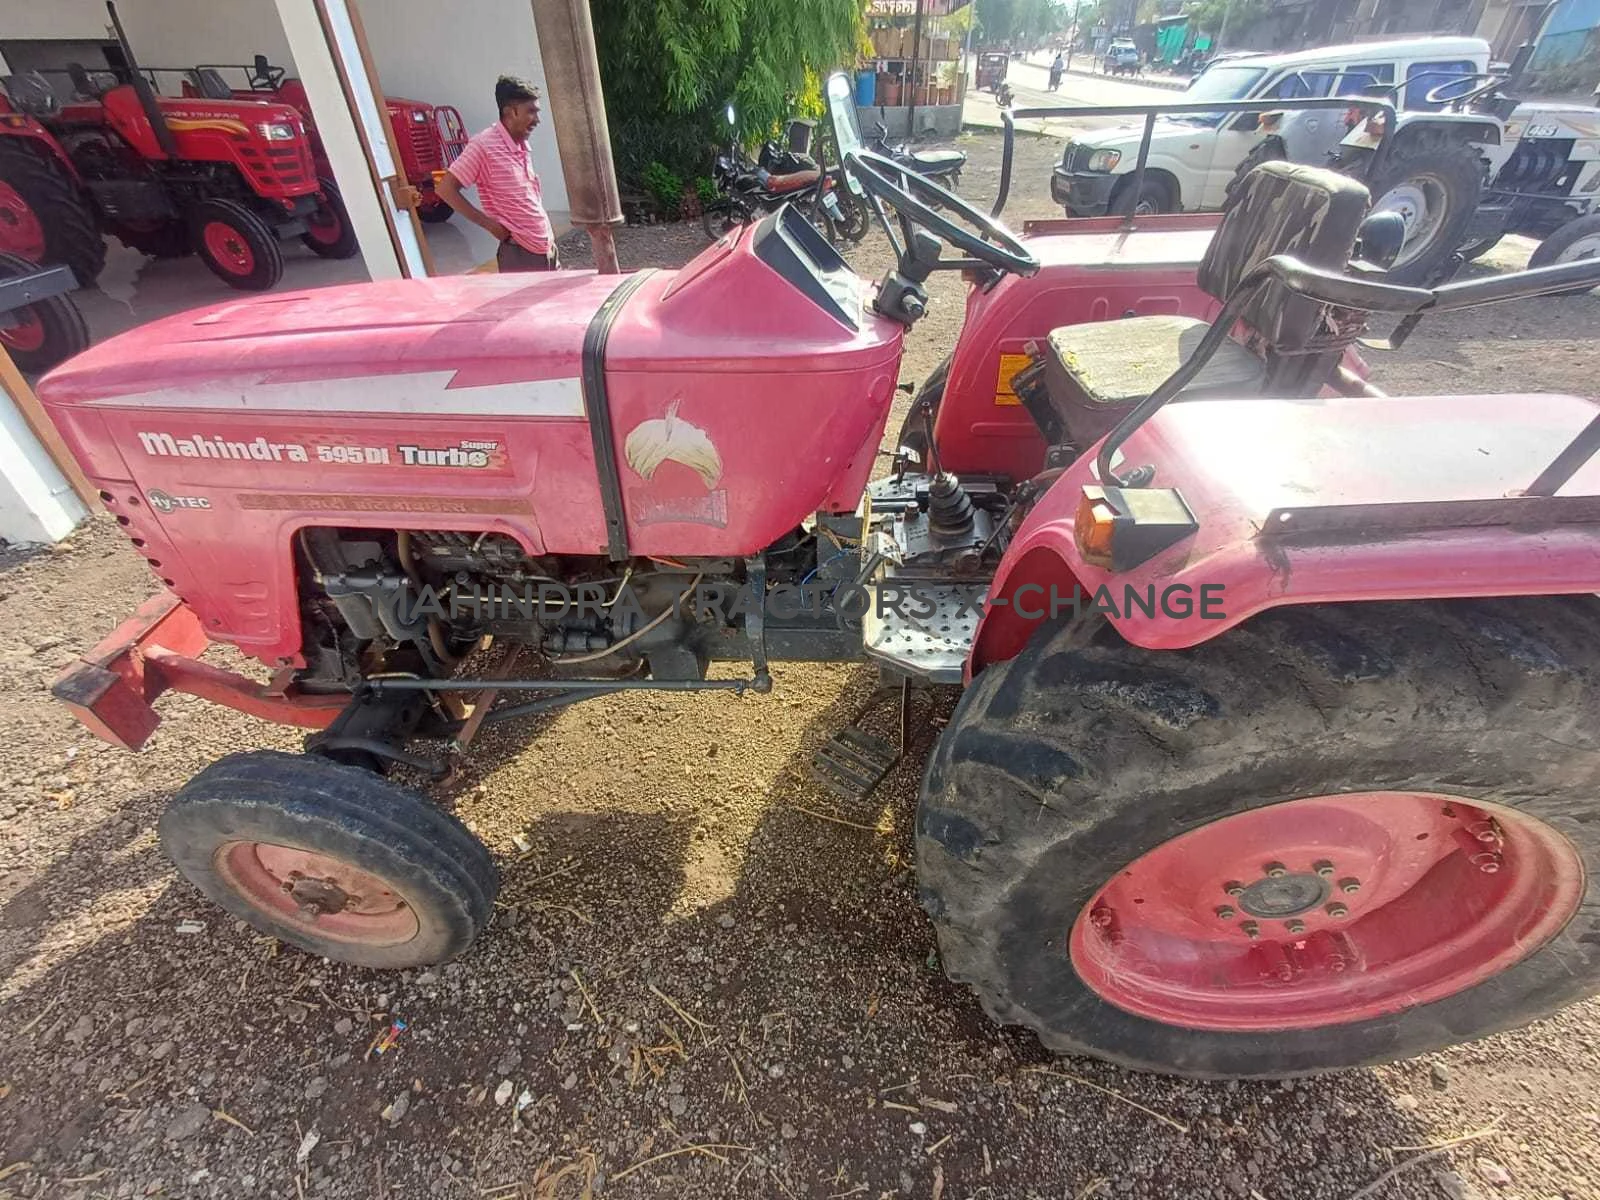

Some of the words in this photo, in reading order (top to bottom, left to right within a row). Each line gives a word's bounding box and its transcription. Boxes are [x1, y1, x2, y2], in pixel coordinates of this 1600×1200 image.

[138, 431, 309, 462] Mahindra
[398, 445, 489, 467] Turbo
[460, 440, 498, 450] Super
